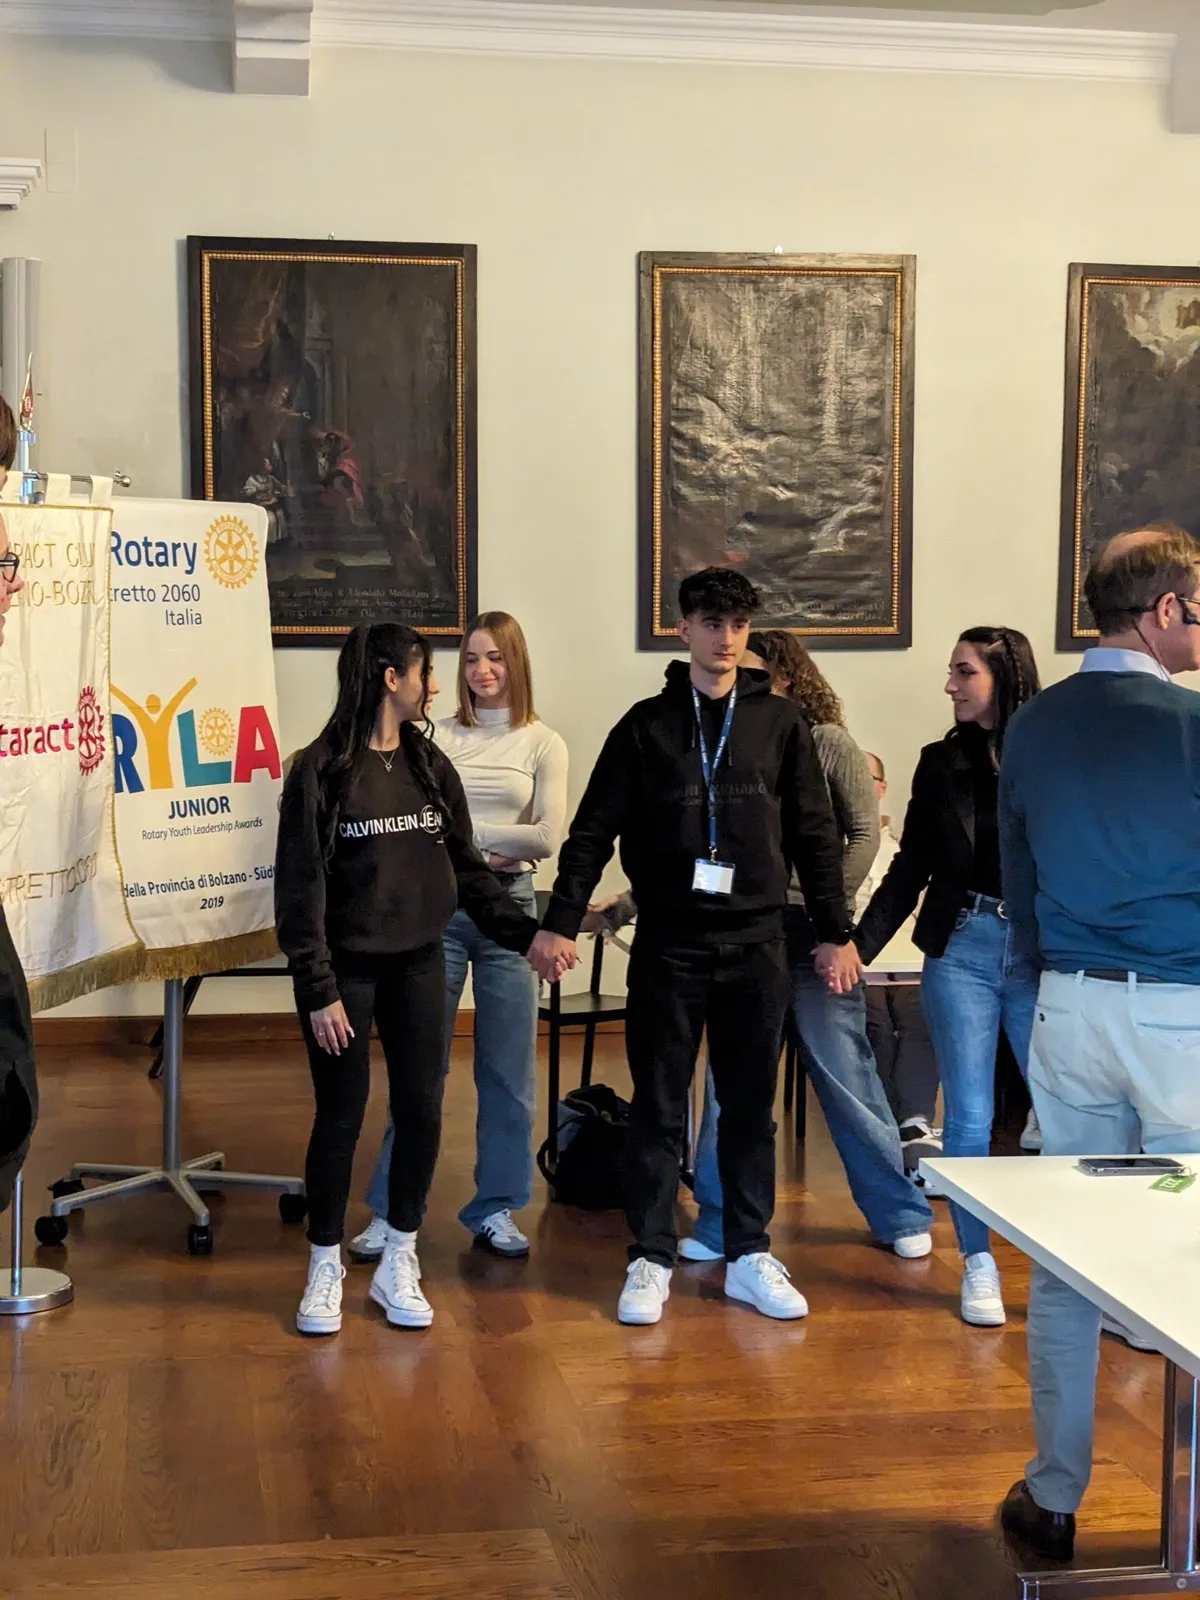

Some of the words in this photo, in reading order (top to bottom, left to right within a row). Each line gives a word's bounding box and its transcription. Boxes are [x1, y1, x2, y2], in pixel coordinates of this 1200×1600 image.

[111, 531, 198, 575] Rotary
[161, 583, 200, 602] 2060
[165, 609, 202, 626] Italia
[110, 676, 281, 793] RYLA
[168, 795, 231, 819] JUNIOR
[142, 830, 168, 840] Rotary
[169, 825, 192, 838] Youth
[193, 821, 233, 834] Leadership
[234, 816, 263, 830] Awards
[339, 818, 383, 838] CALVIN
[384, 813, 419, 833] KLEIN
[147, 876, 196, 895] Provincia
[197, 874, 208, 889] di
[208, 871, 247, 886] Bolzano
[200, 896, 224, 910] 2019
